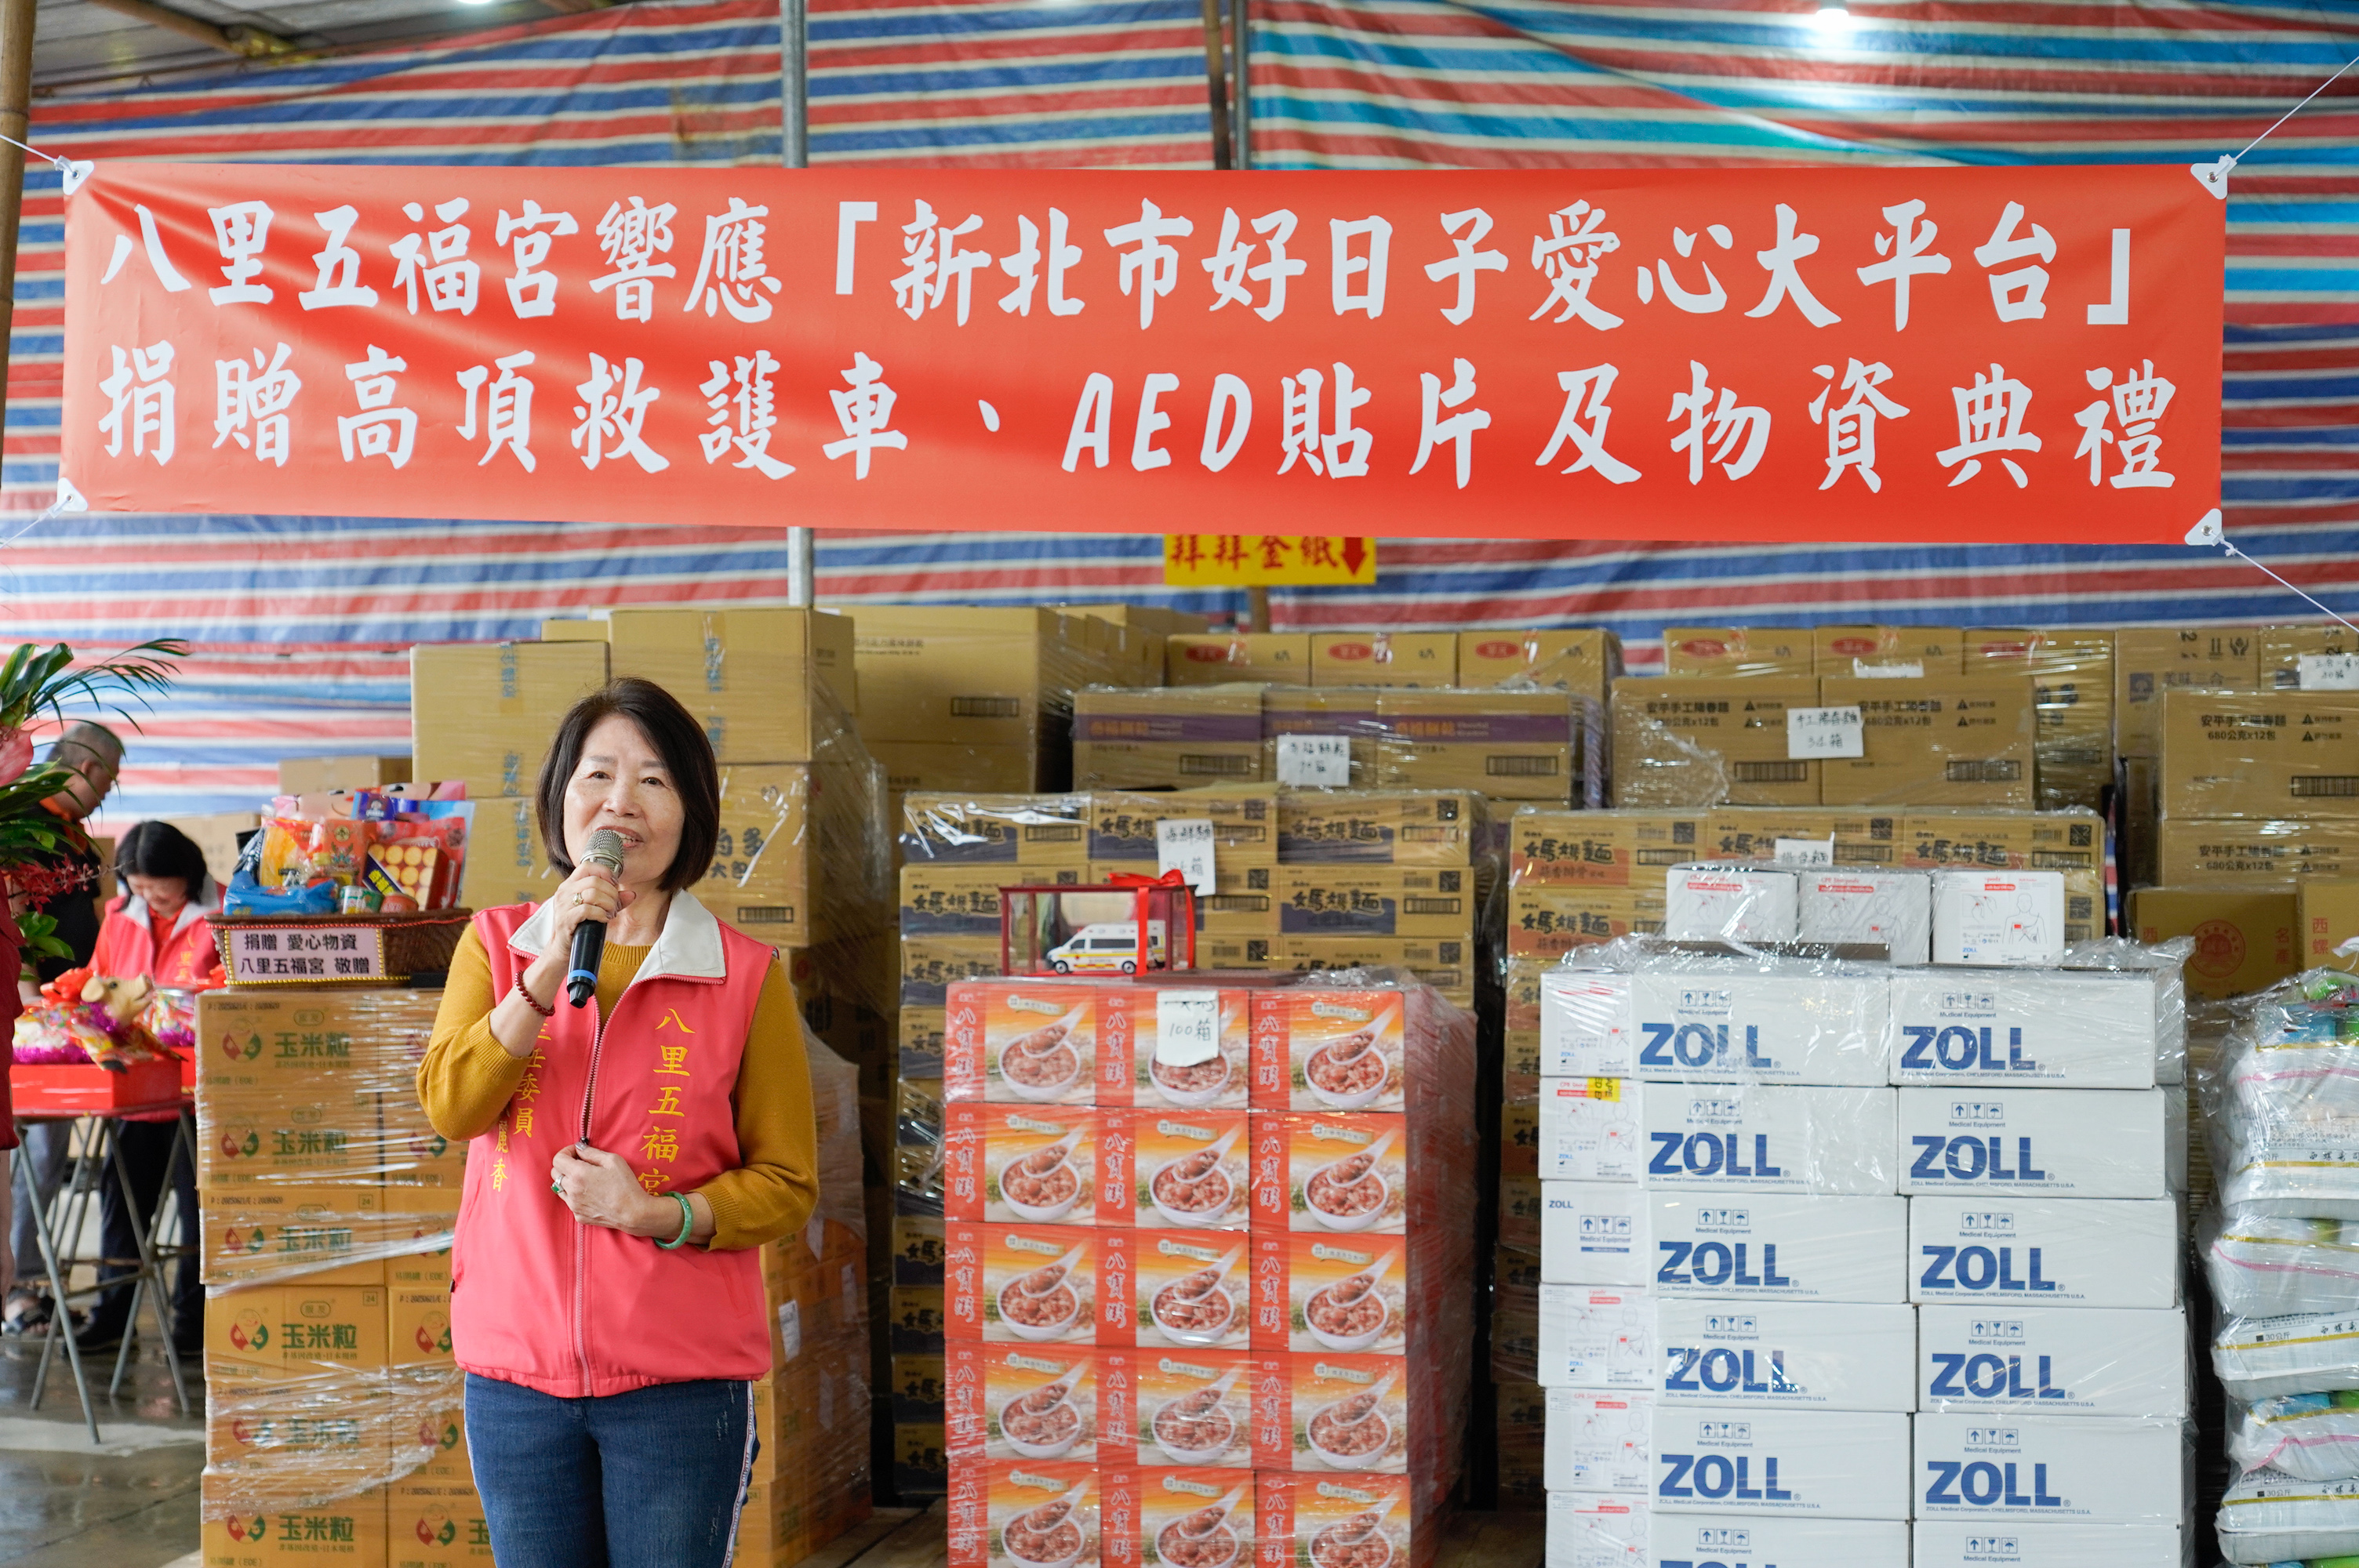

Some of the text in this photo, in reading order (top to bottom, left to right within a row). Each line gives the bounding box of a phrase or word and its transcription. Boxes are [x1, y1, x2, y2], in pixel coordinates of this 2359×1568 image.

[101, 196, 2131, 332] 八里五福宮響應「新北市好日子愛心大平台」
[99, 339, 2177, 494] 捐贈高頂救護車、AED貼片及物資典禮
[244, 933, 358, 951] 捐贈 愛心物資
[240, 956, 369, 975] 八里五福宮 敬贈
[274, 1032, 351, 1058] 玉米粒
[1169, 1018, 1212, 1041] 100箱
[1640, 1023, 1772, 1067] ZOLL
[1902, 1026, 2036, 1070] ZOLL
[638, 1007, 696, 1196] 八里五福宮
[272, 1130, 347, 1156] 玉米粒
[1649, 1133, 1780, 1176] ZOLL
[1911, 1136, 2045, 1180] ZOLL
[1658, 1242, 1790, 1286] ZOLL
[1921, 1246, 2055, 1290] ZOLL
[281, 1323, 358, 1349] 玉米粒
[2266, 1332, 2290, 1341] 30公斤
[1666, 1348, 1799, 1393] ZOLL
[1931, 1353, 2066, 1398] ZOLL
[1659, 1454, 1791, 1500] ZOLL
[1926, 1461, 2061, 1506] ZOLL
[278, 1515, 354, 1542] 玉米粒
